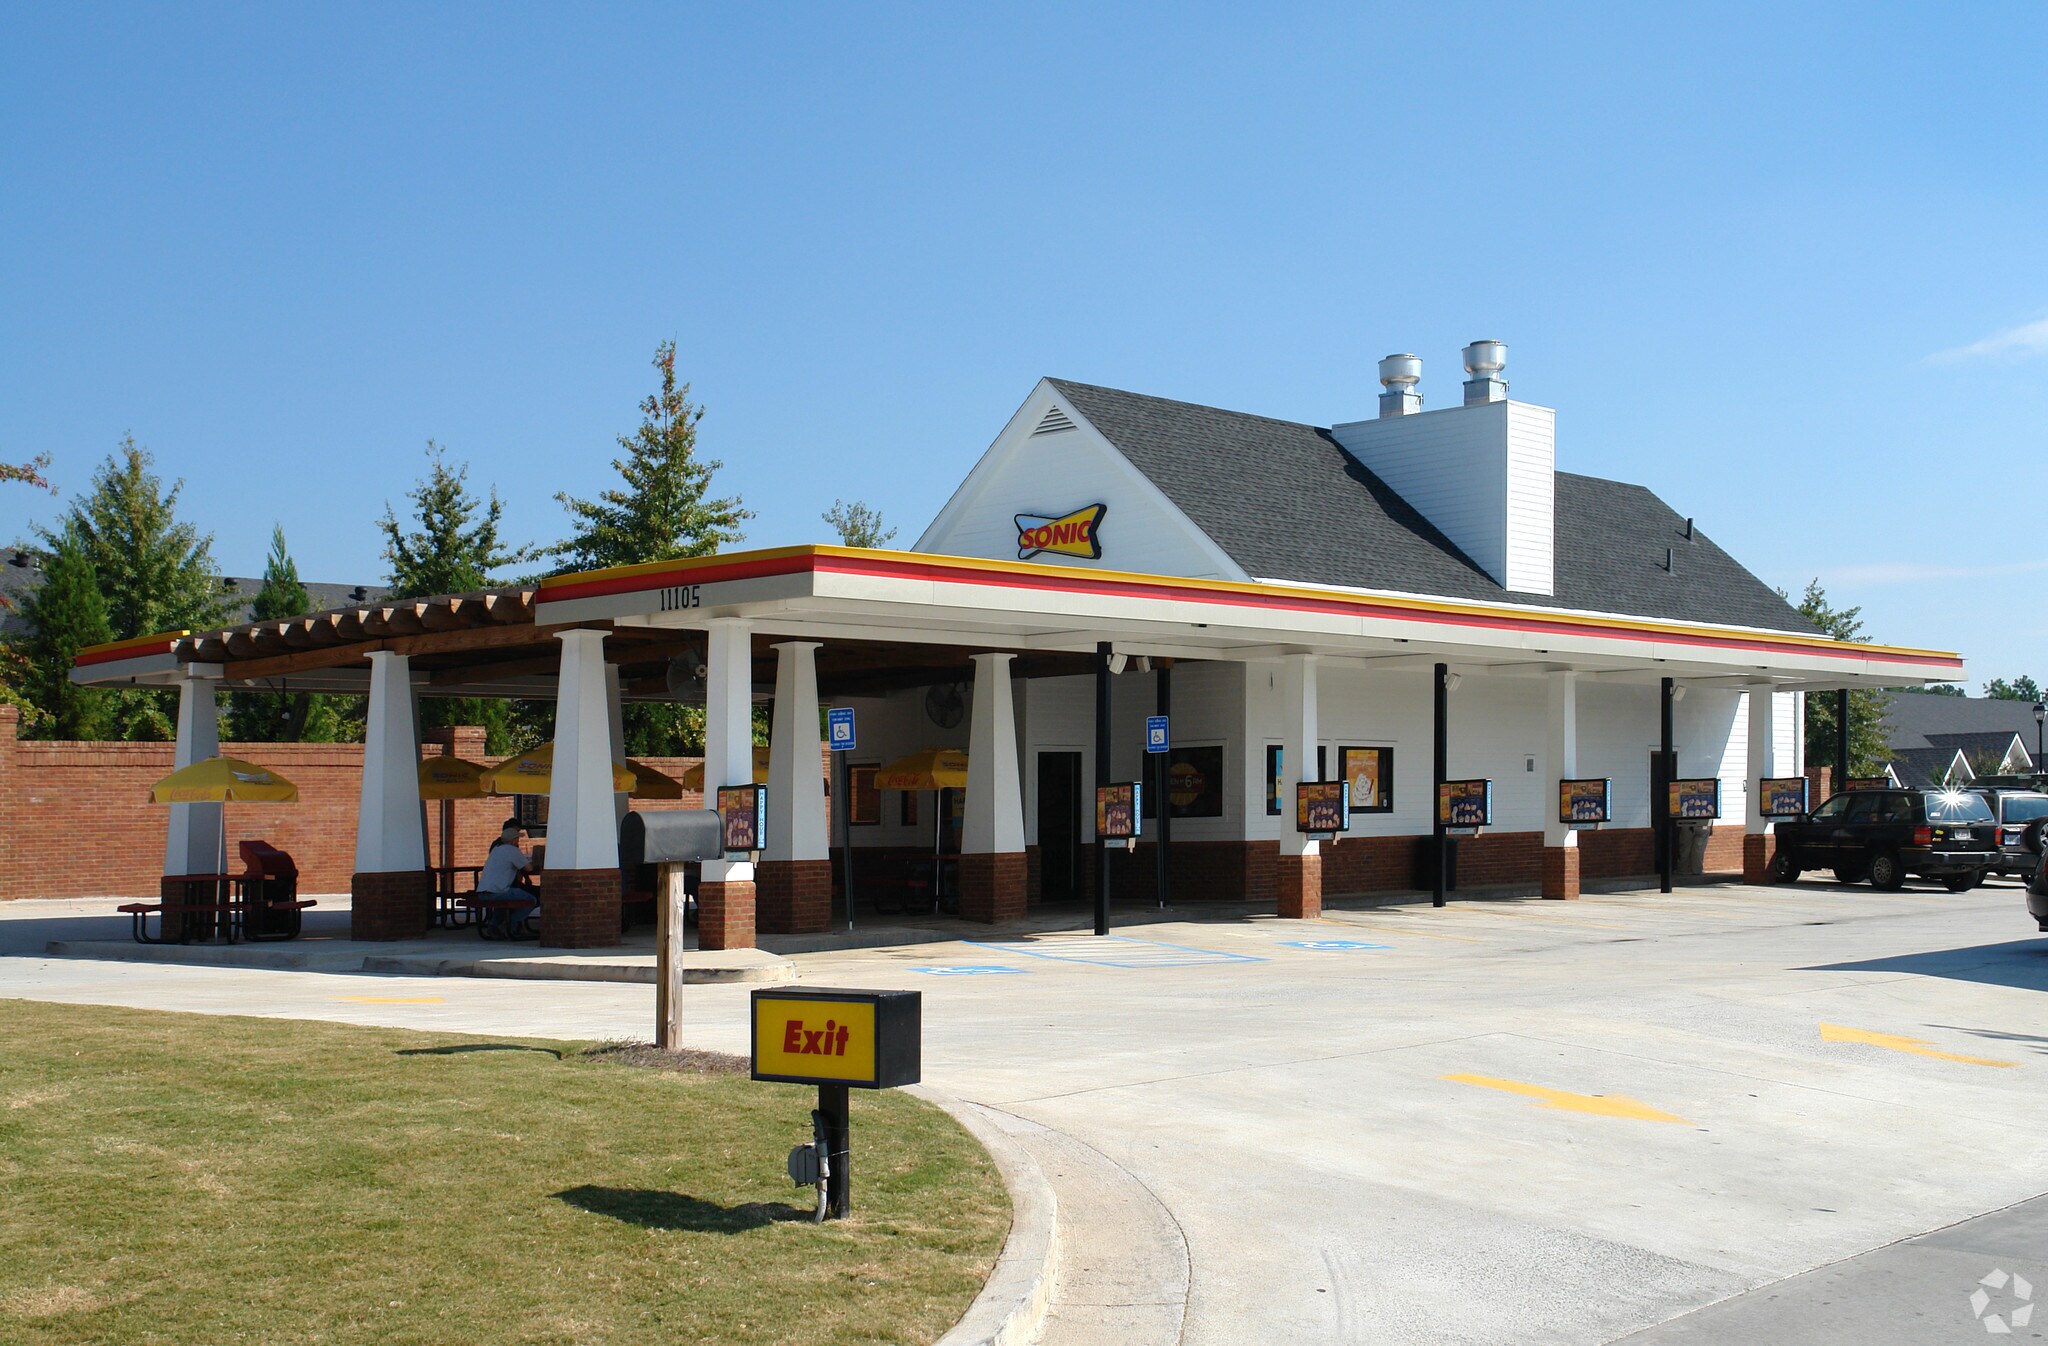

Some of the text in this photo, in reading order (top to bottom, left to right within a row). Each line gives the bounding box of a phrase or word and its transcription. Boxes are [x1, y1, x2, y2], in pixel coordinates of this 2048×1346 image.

[1021, 520, 1092, 550] SONIC
[660, 585, 700, 611] 11105
[782, 1019, 849, 1056] Exit
